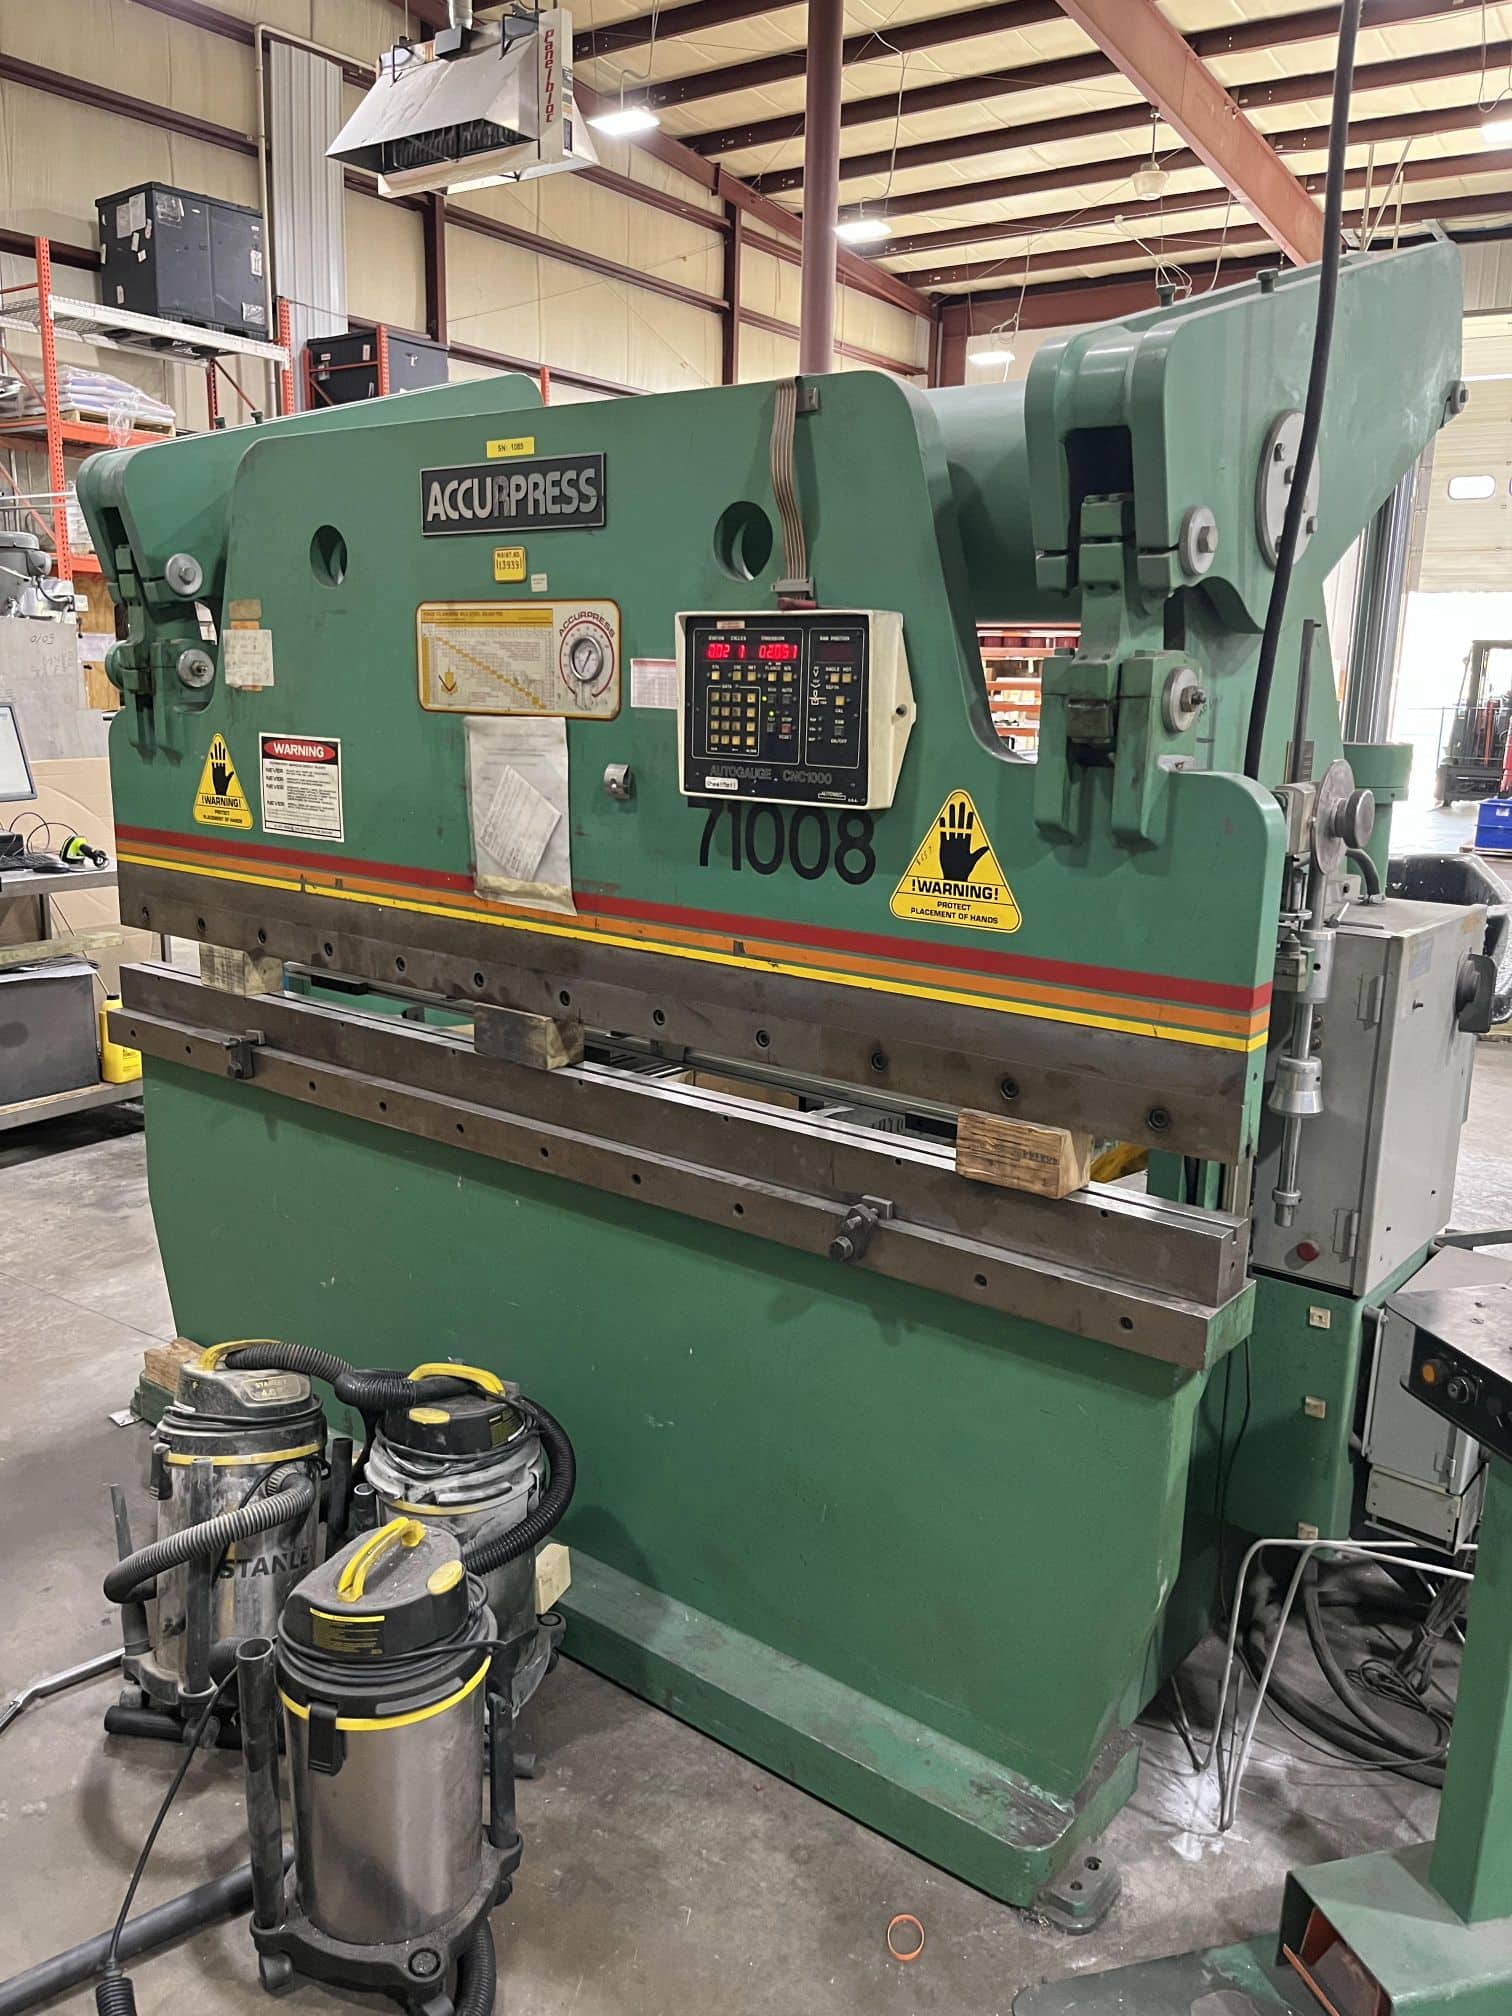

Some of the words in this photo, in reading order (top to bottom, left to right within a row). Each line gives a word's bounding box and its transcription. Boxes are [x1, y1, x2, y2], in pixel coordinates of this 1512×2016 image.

[427, 468, 598, 522] ACCURPRESS
[559, 610, 616, 639] ACCURPRESS
[273, 742, 325, 759] WARNING
[688, 795, 877, 886] 71008
[910, 907, 956, 920] PLACEMENT
[958, 912, 969, 921] OF
[970, 913, 999, 925] HANDS
[937, 901, 971, 911] PROTECT
